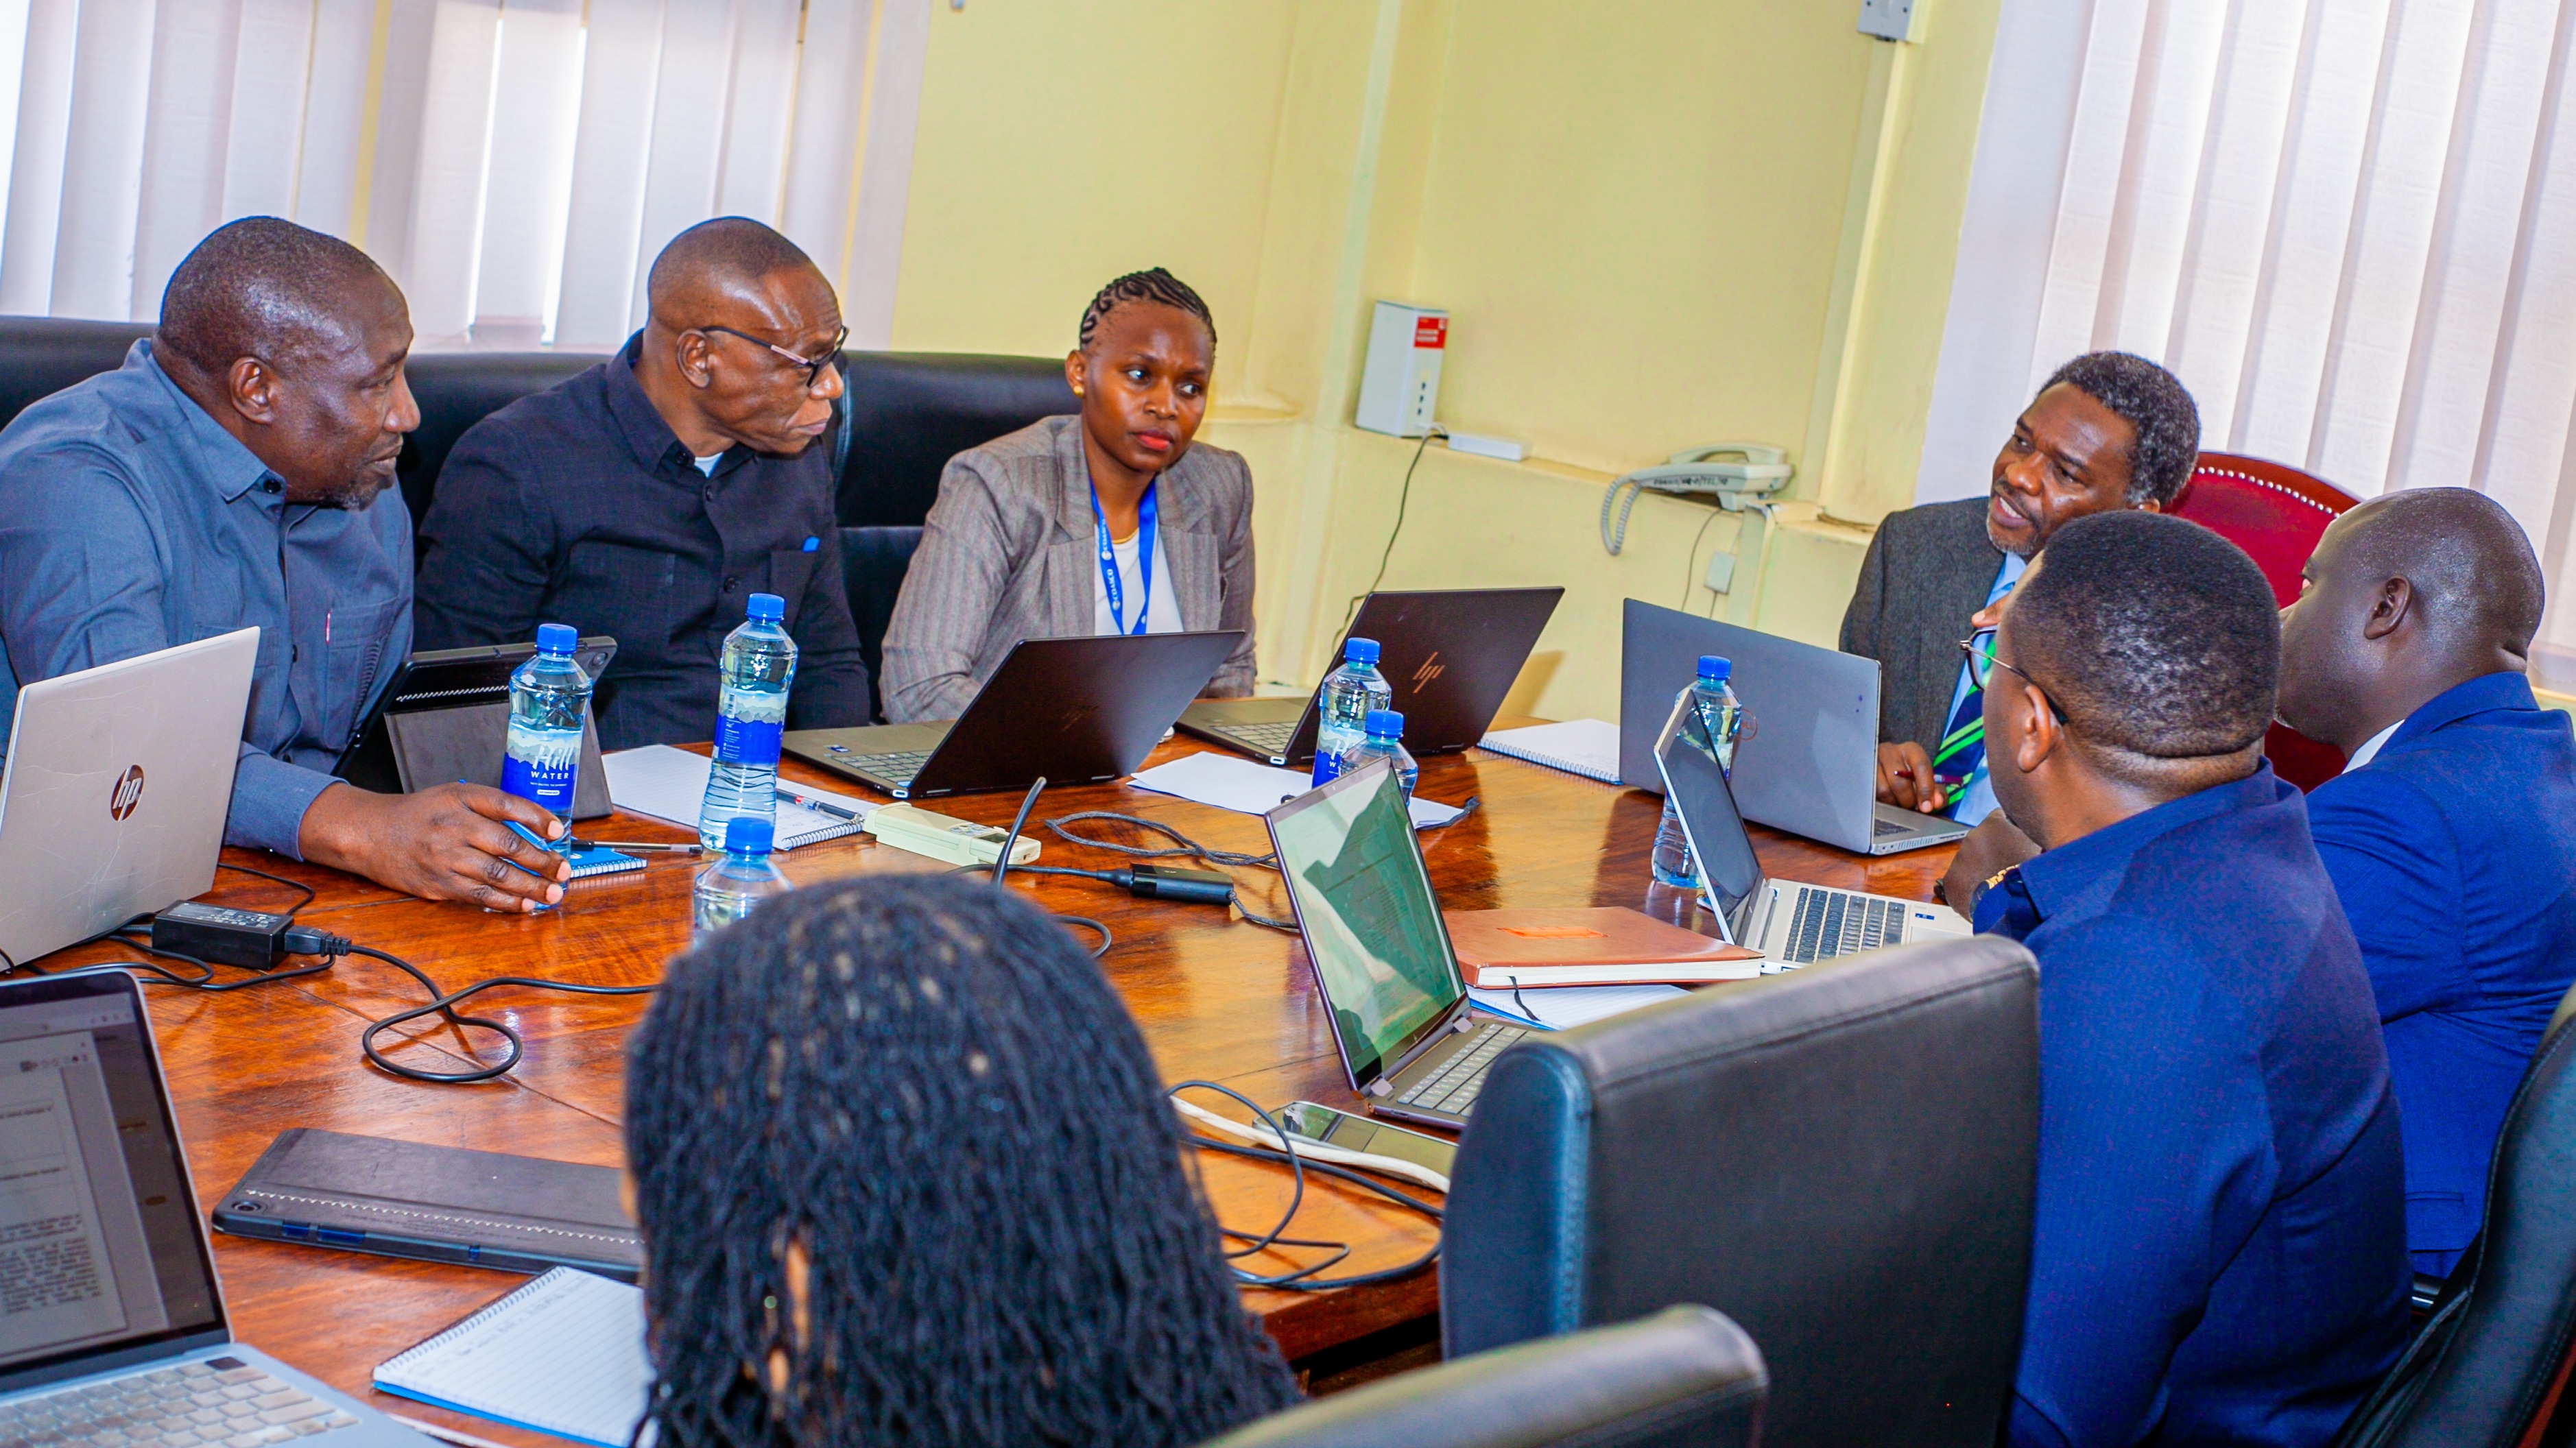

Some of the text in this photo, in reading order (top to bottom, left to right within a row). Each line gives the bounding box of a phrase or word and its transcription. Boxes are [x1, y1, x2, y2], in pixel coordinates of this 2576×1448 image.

[1106, 568, 1119, 601] COASCO
[1412, 651, 1446, 694] hp
[532, 744, 575, 771] Hill
[530, 771, 569, 780] WATER
[112, 767, 143, 821] hp
